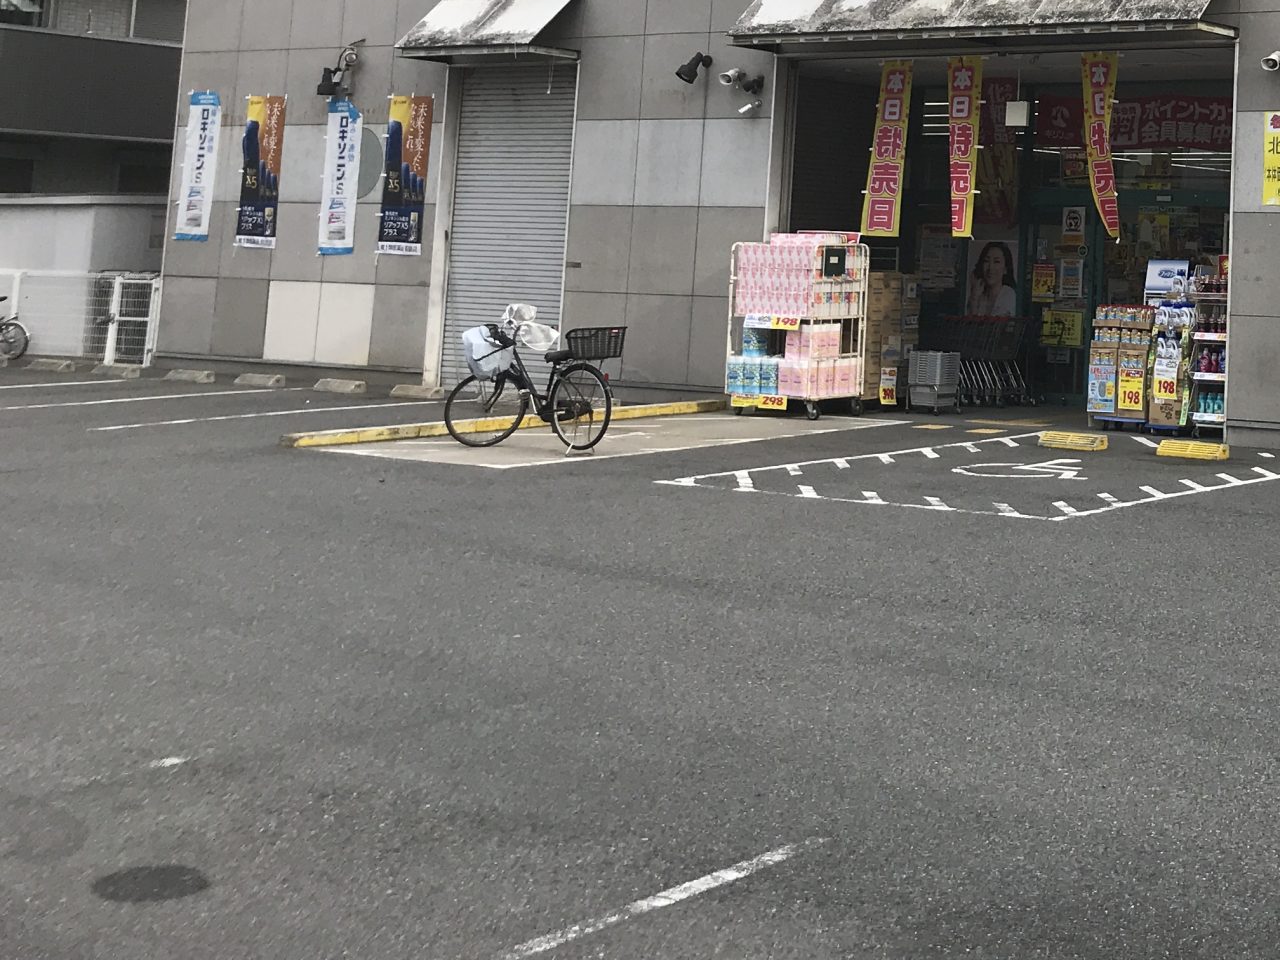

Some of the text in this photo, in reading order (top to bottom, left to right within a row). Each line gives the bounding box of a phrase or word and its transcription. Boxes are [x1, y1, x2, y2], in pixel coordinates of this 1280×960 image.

[1144, 100, 1233, 121] ポイントカ
[949, 68, 974, 232] 本日特売日
[774, 317, 799, 326] 198
[1157, 380, 1175, 394] 198
[761, 396, 784, 406] 298
[1122, 390, 1140, 405] 198
